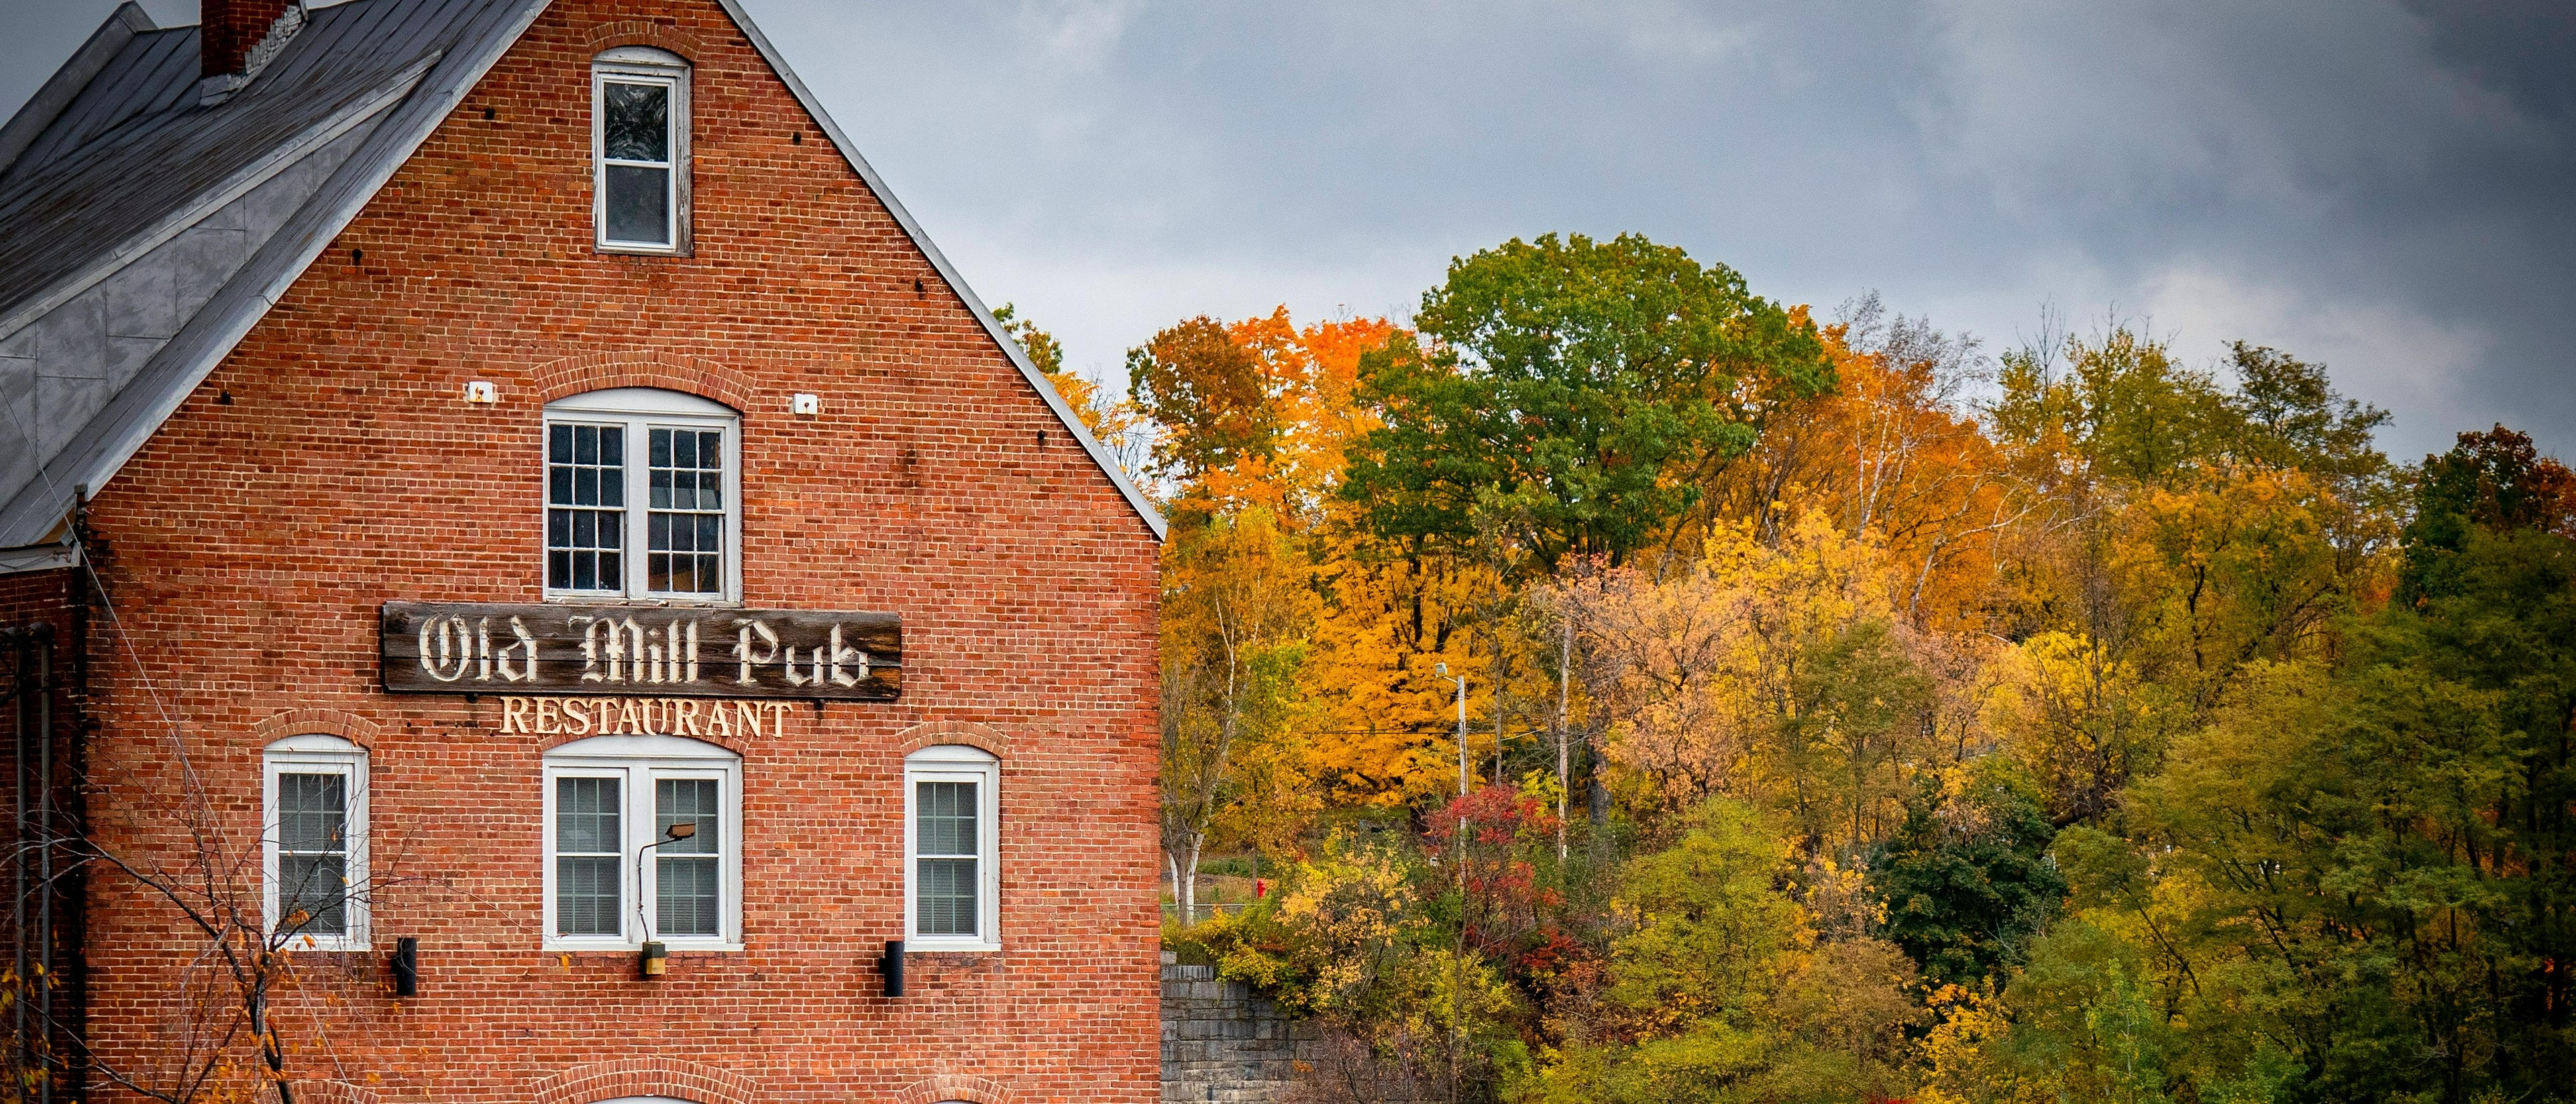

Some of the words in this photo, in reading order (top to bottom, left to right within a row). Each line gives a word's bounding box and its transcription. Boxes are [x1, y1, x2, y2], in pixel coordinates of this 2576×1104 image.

[419, 613, 537, 682] Old
[568, 615, 699, 685] Mill
[732, 619, 869, 687] Pub
[500, 696, 793, 738] RESTAURANT
